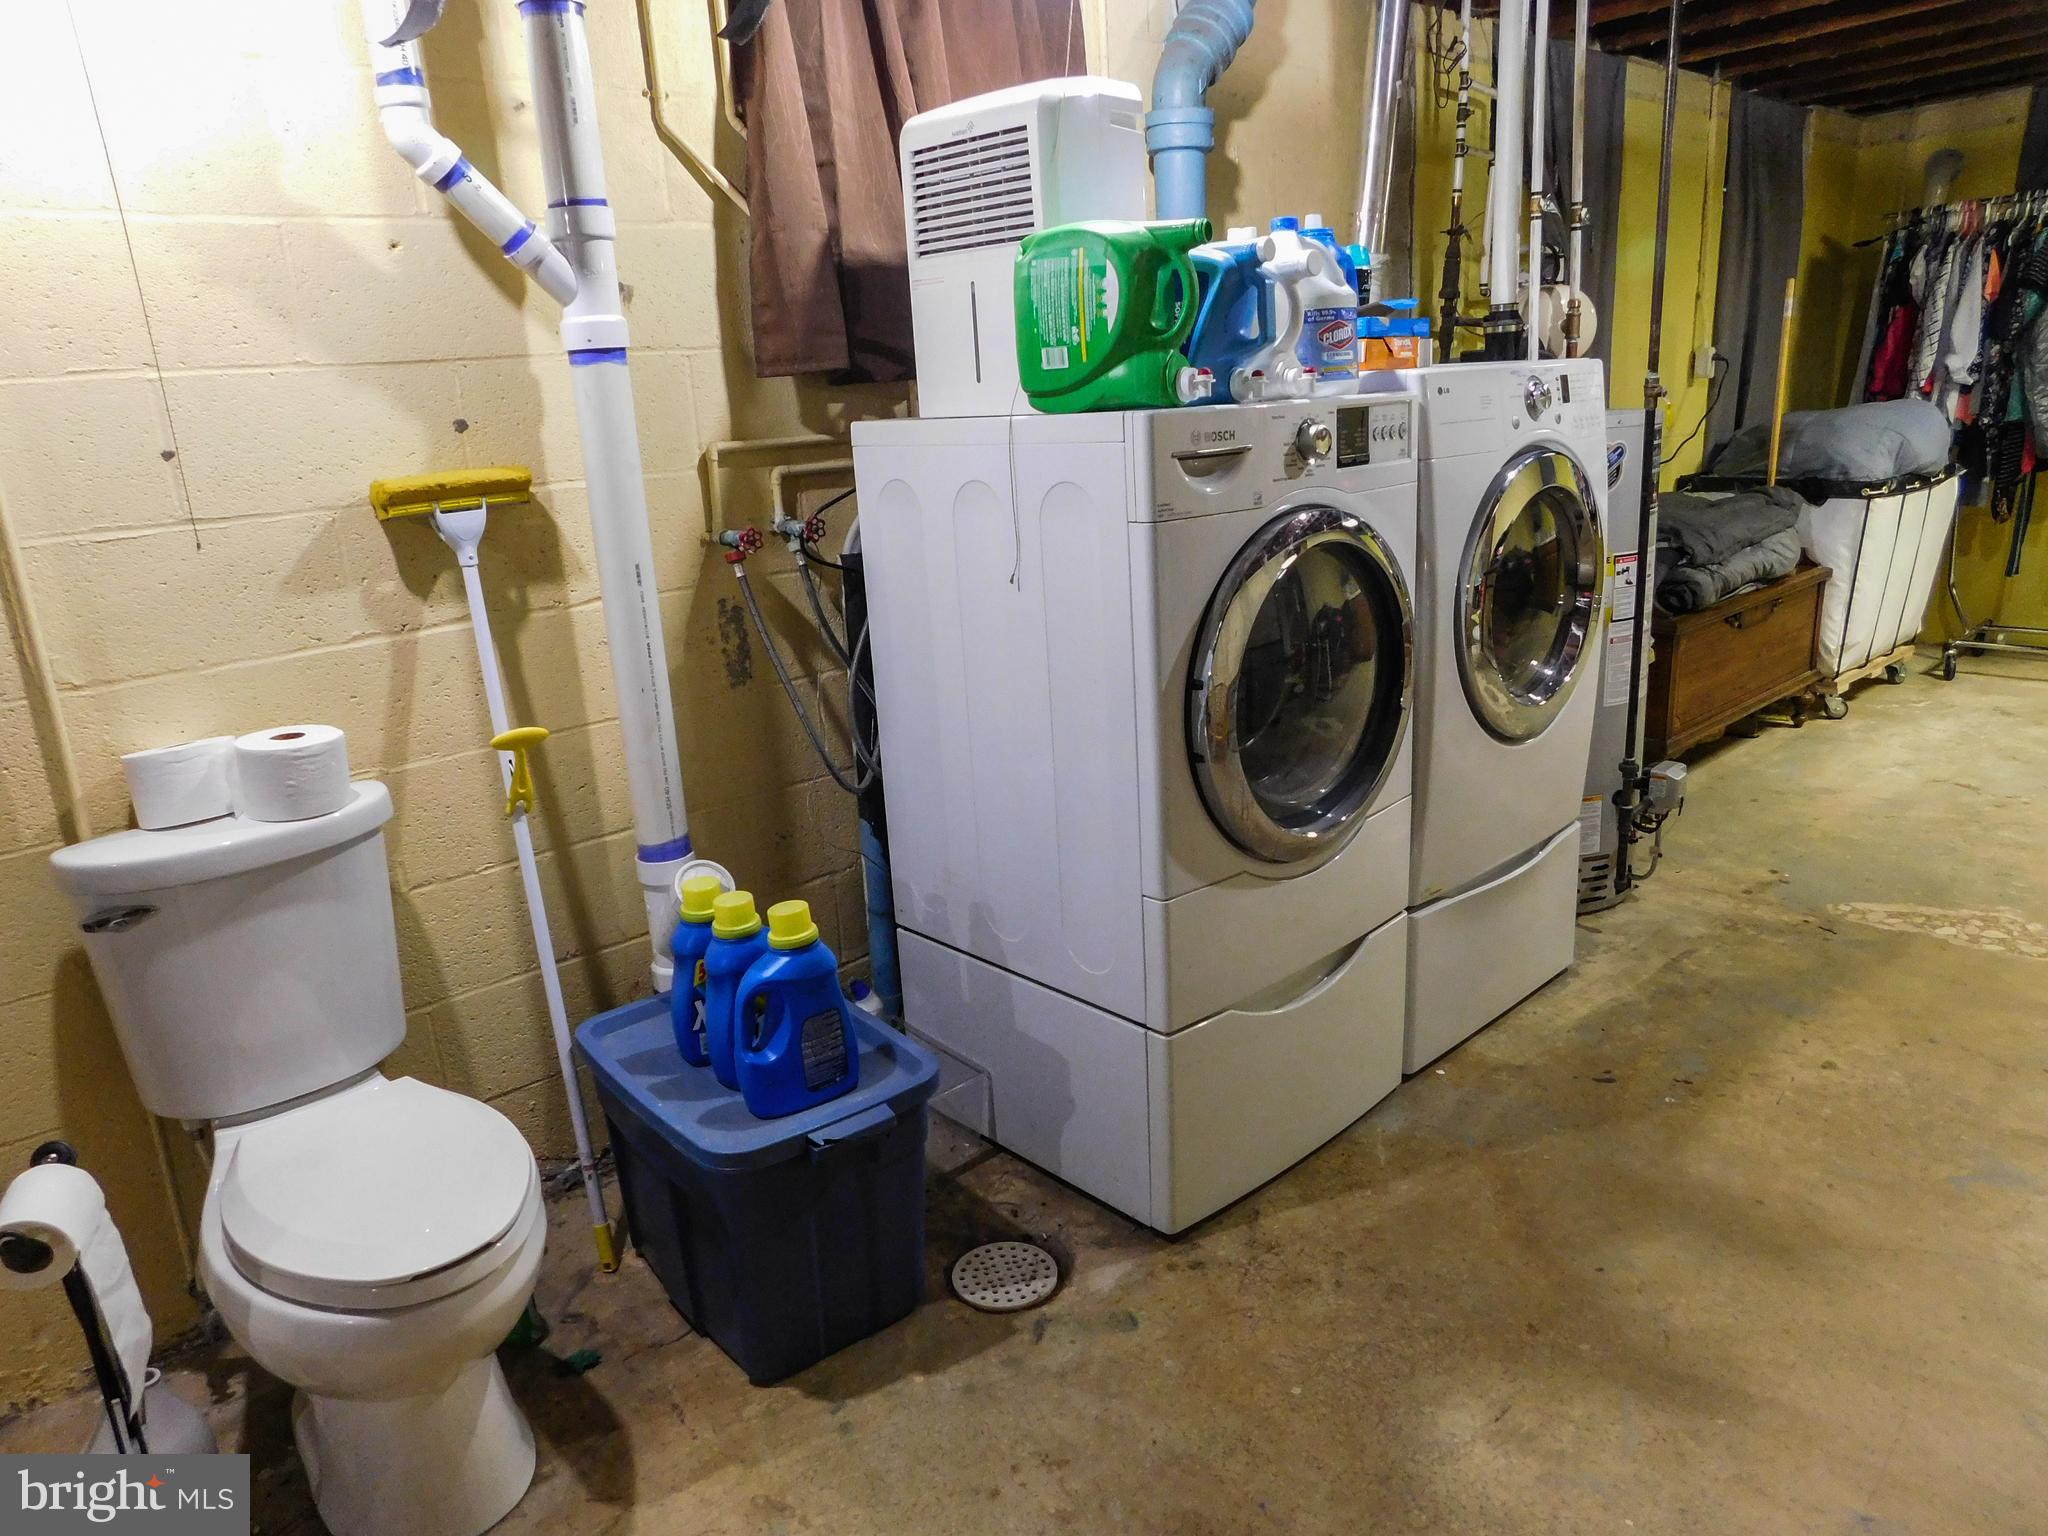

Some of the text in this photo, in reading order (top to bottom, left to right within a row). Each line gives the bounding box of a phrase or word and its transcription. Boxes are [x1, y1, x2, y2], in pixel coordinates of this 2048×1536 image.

[1306, 309, 1320, 317] Kills
[1323, 324, 1353, 344] CLOROX
[1204, 430, 1236, 442] BOSCH
